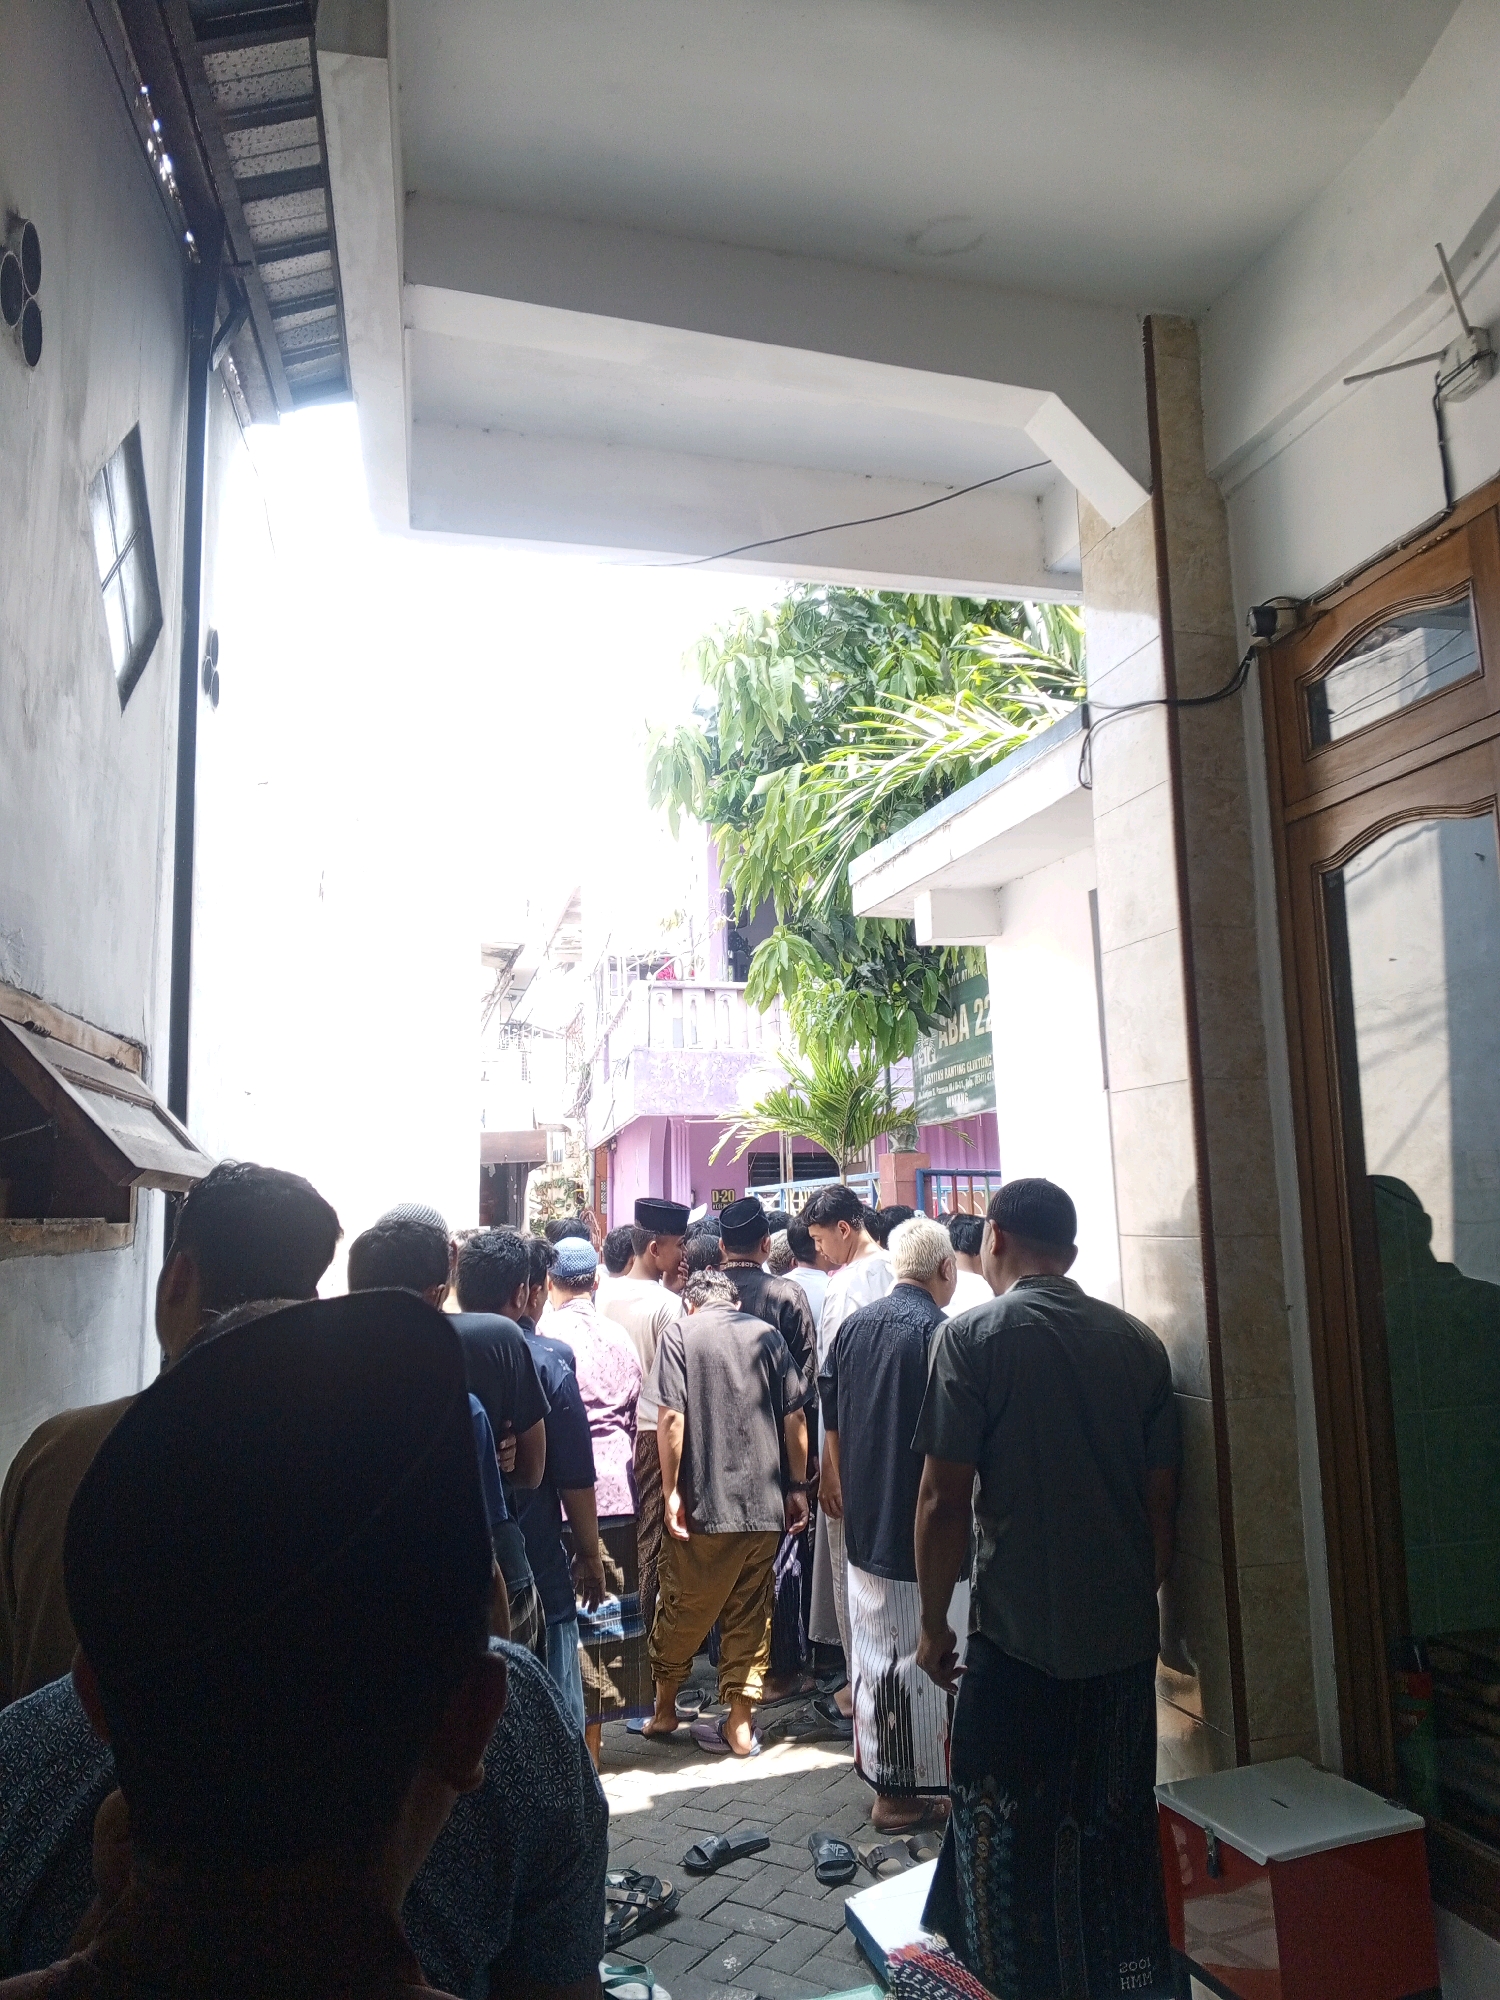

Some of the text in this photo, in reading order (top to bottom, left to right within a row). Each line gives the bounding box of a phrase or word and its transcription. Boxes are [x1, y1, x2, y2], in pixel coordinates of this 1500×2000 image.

[938, 1003, 970, 1049] ABA
[712, 1190, 734, 1203] D-20
[1119, 1957, 1151, 1973] 2001
[1120, 1971, 1153, 1990] HMM
